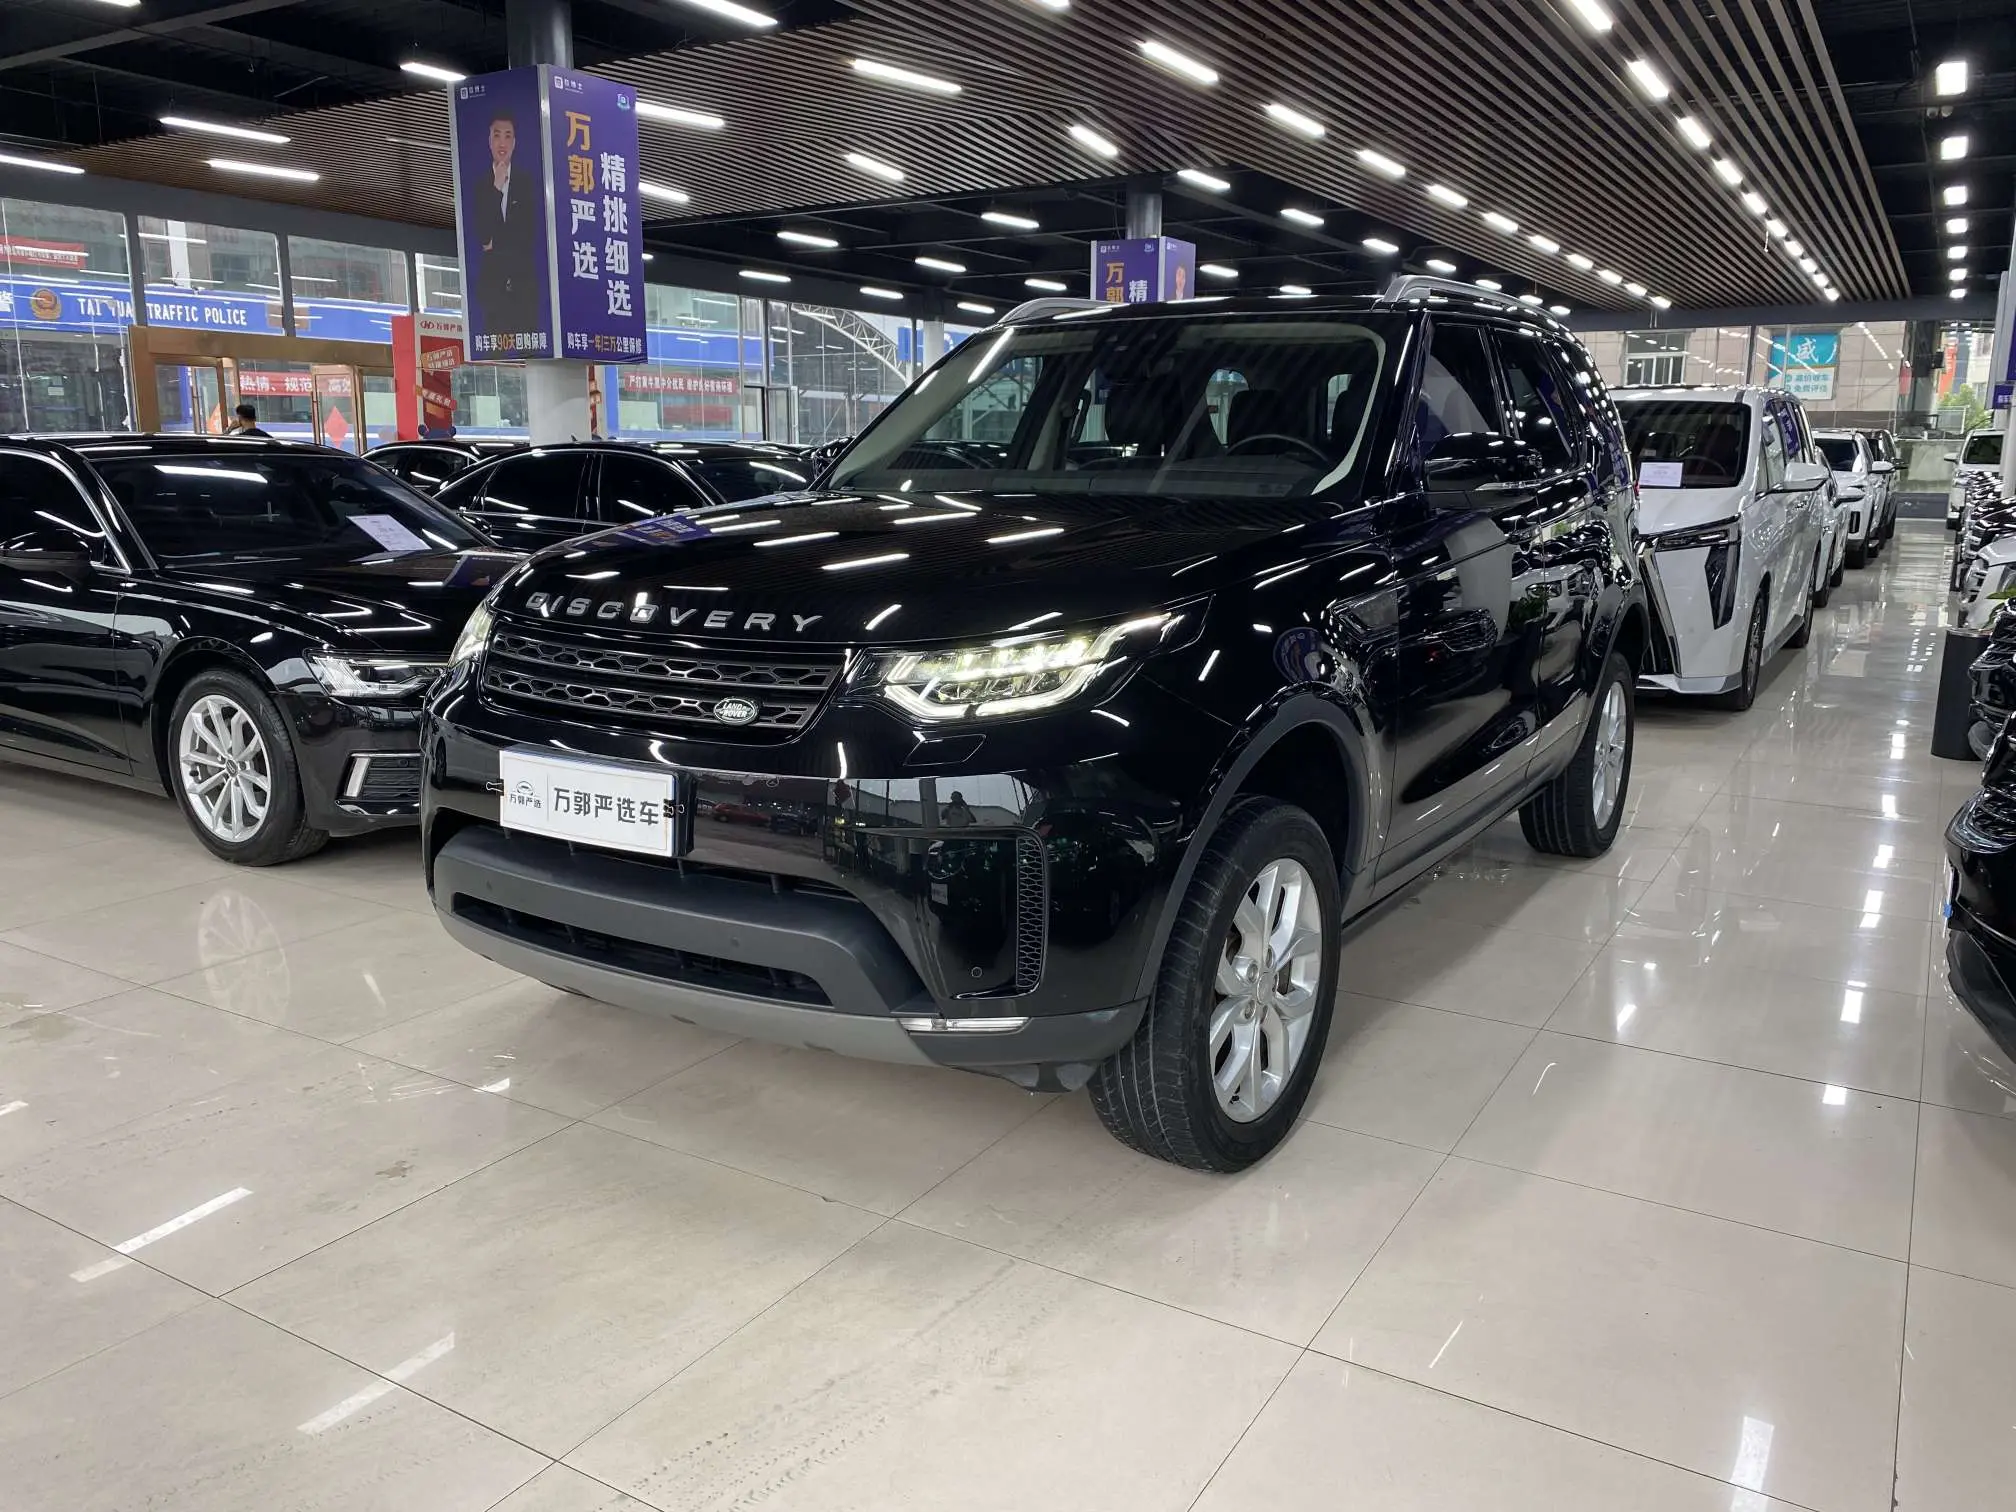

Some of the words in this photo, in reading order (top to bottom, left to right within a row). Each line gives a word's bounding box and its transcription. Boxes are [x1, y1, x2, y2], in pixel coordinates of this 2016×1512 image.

[564, 110, 599, 280] 万郭严选
[600, 152, 633, 317] 精挑细选
[1128, 279, 1148, 303] 精
[77, 298, 103, 316] TAI
[110, 300, 135, 318] YUA
[145, 303, 199, 322] TRAFFIC
[204, 307, 248, 326] POLICE
[475, 332, 548, 352] 购车享90天回购保障
[525, 591, 823, 632] DISCOVERY
[722, 702, 743, 711] LAND
[722, 709, 748, 718] ROVER
[509, 793, 542, 809] 万郭严选
[553, 787, 659, 826] 万郭严选车
